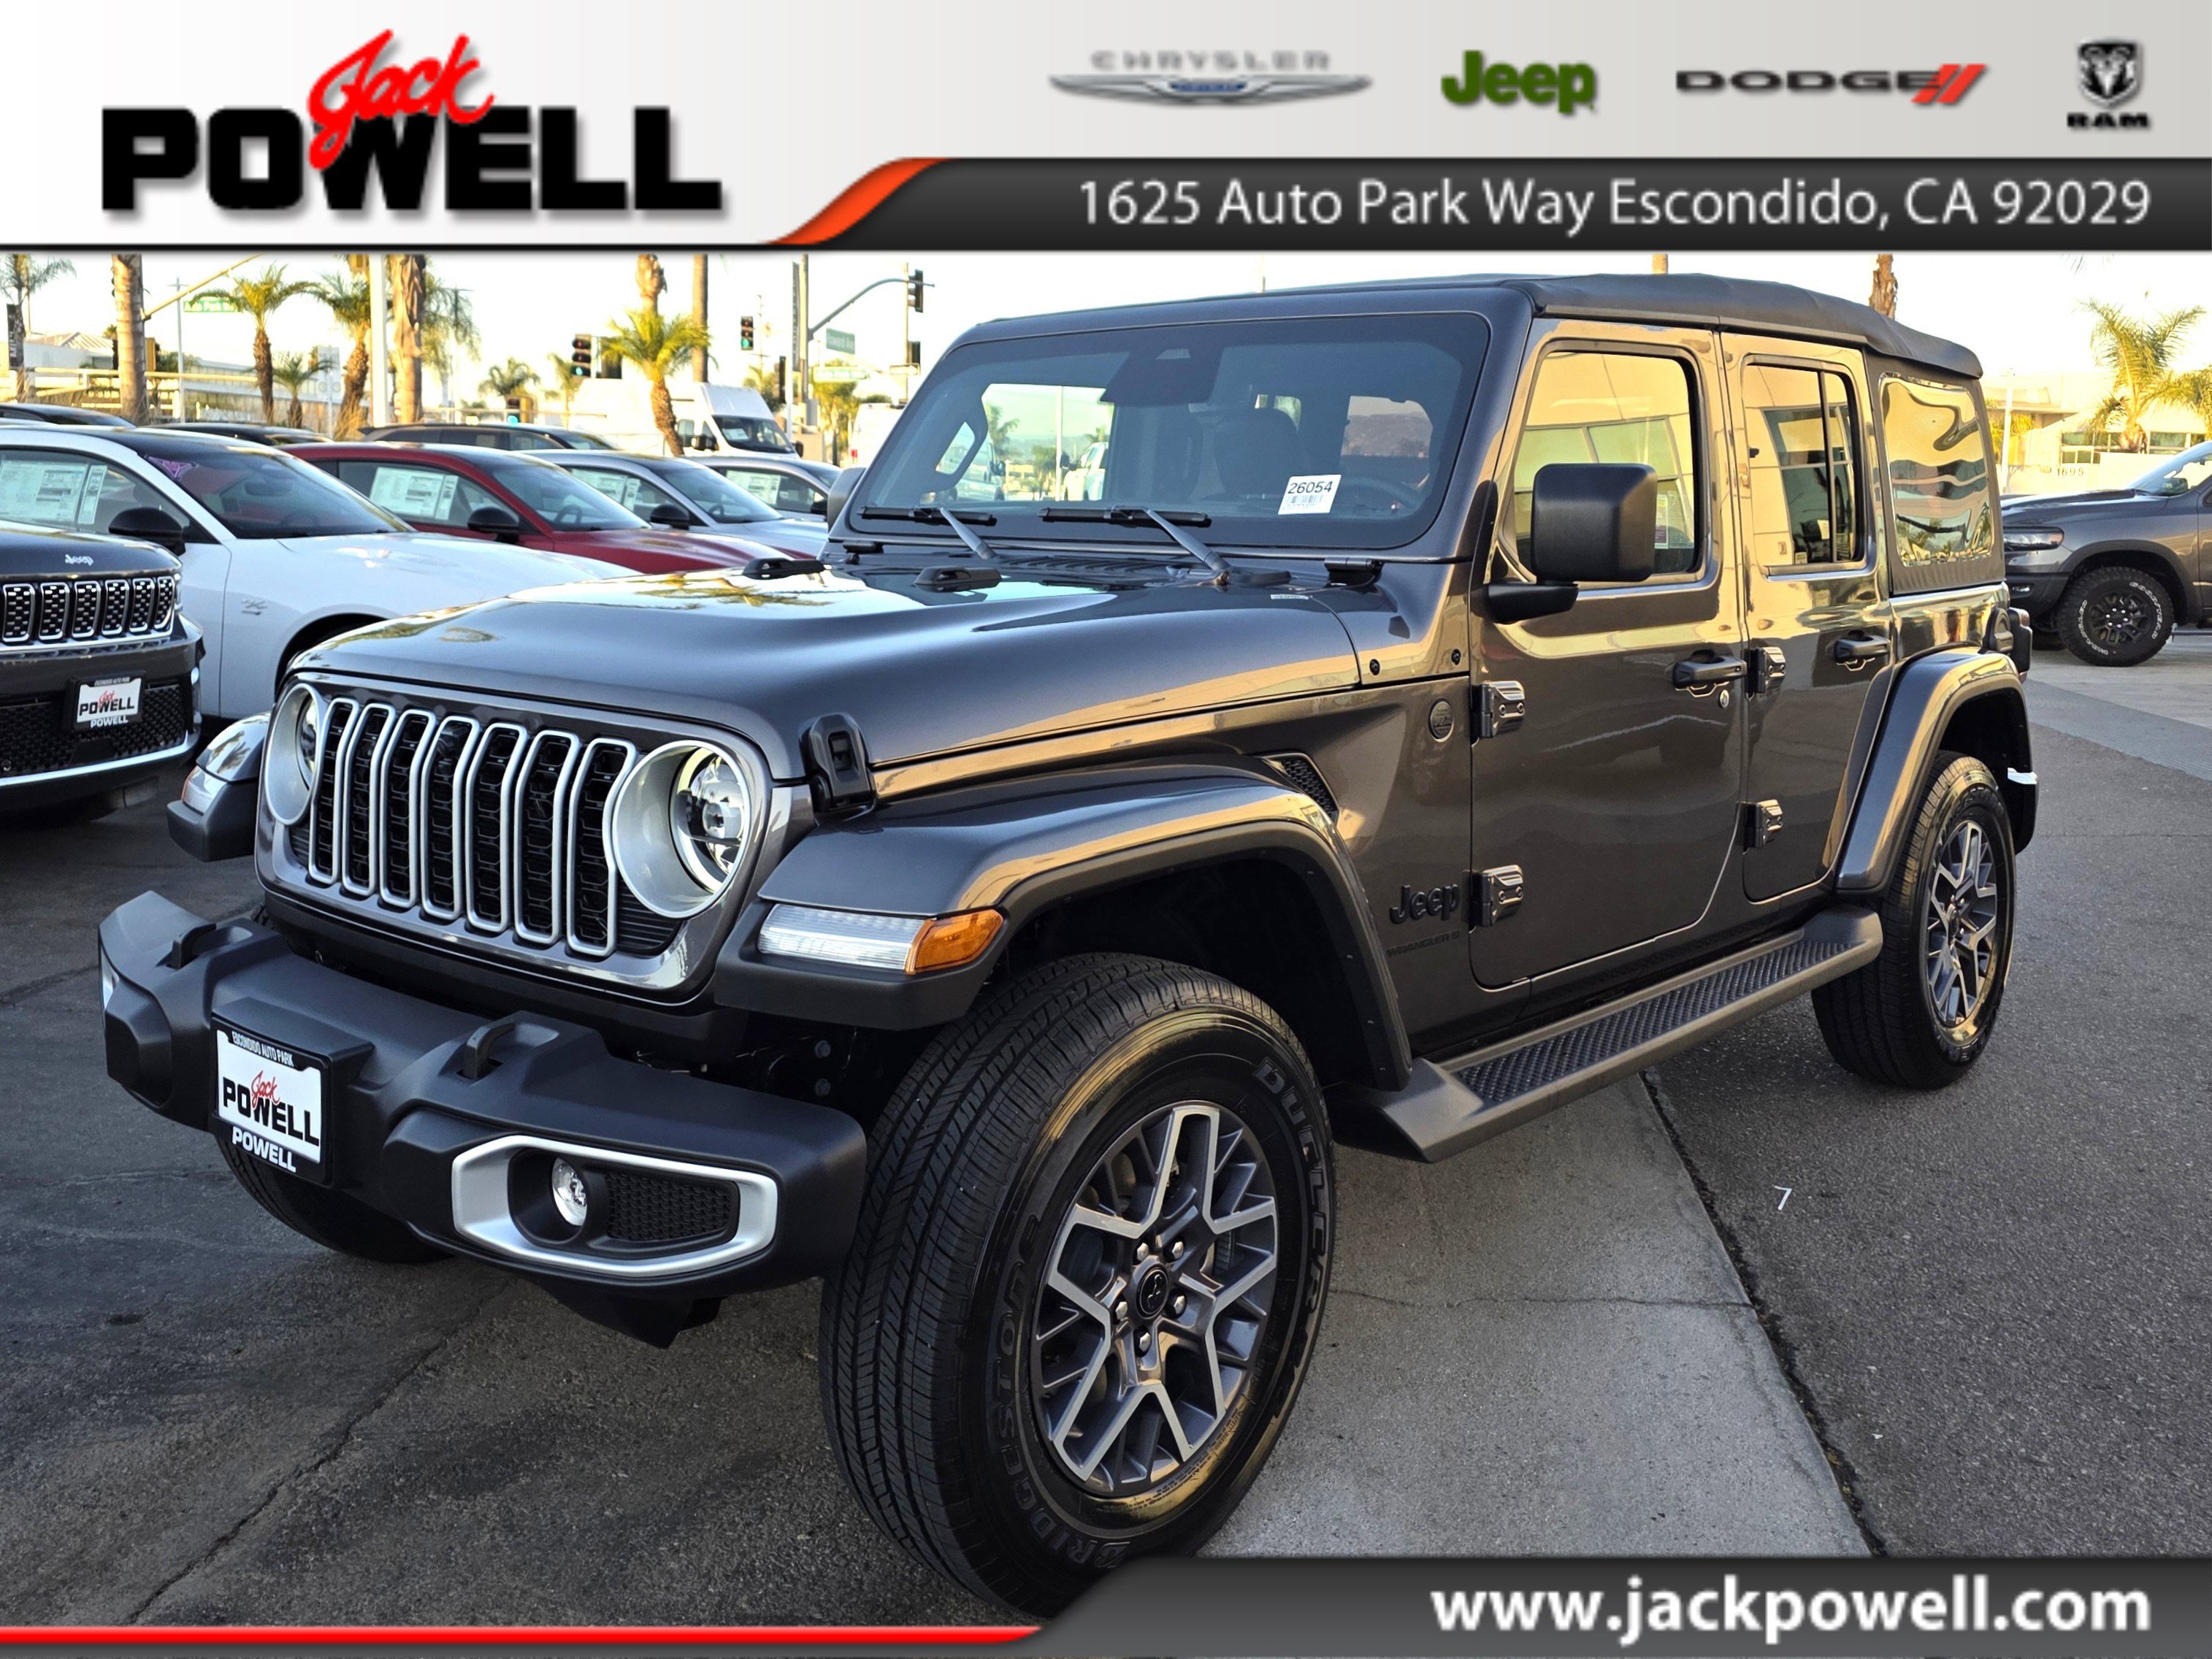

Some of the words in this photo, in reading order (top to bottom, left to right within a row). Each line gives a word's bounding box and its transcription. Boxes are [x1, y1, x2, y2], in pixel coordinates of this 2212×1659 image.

[1287, 480, 1333, 494] 26054
[2056, 467, 2084, 476] 1695
[79, 697, 134, 716] POWELL
[90, 716, 129, 729] POWELL
[1389, 883, 1461, 925] Jeep
[231, 1030, 261, 1054] ESCONDIDO
[261, 1043, 277, 1060] AUTO
[276, 1049, 295, 1068] PARK
[250, 1070, 280, 1110] Jack
[222, 1076, 321, 1147] POWELL
[231, 1125, 297, 1173] POWELL
